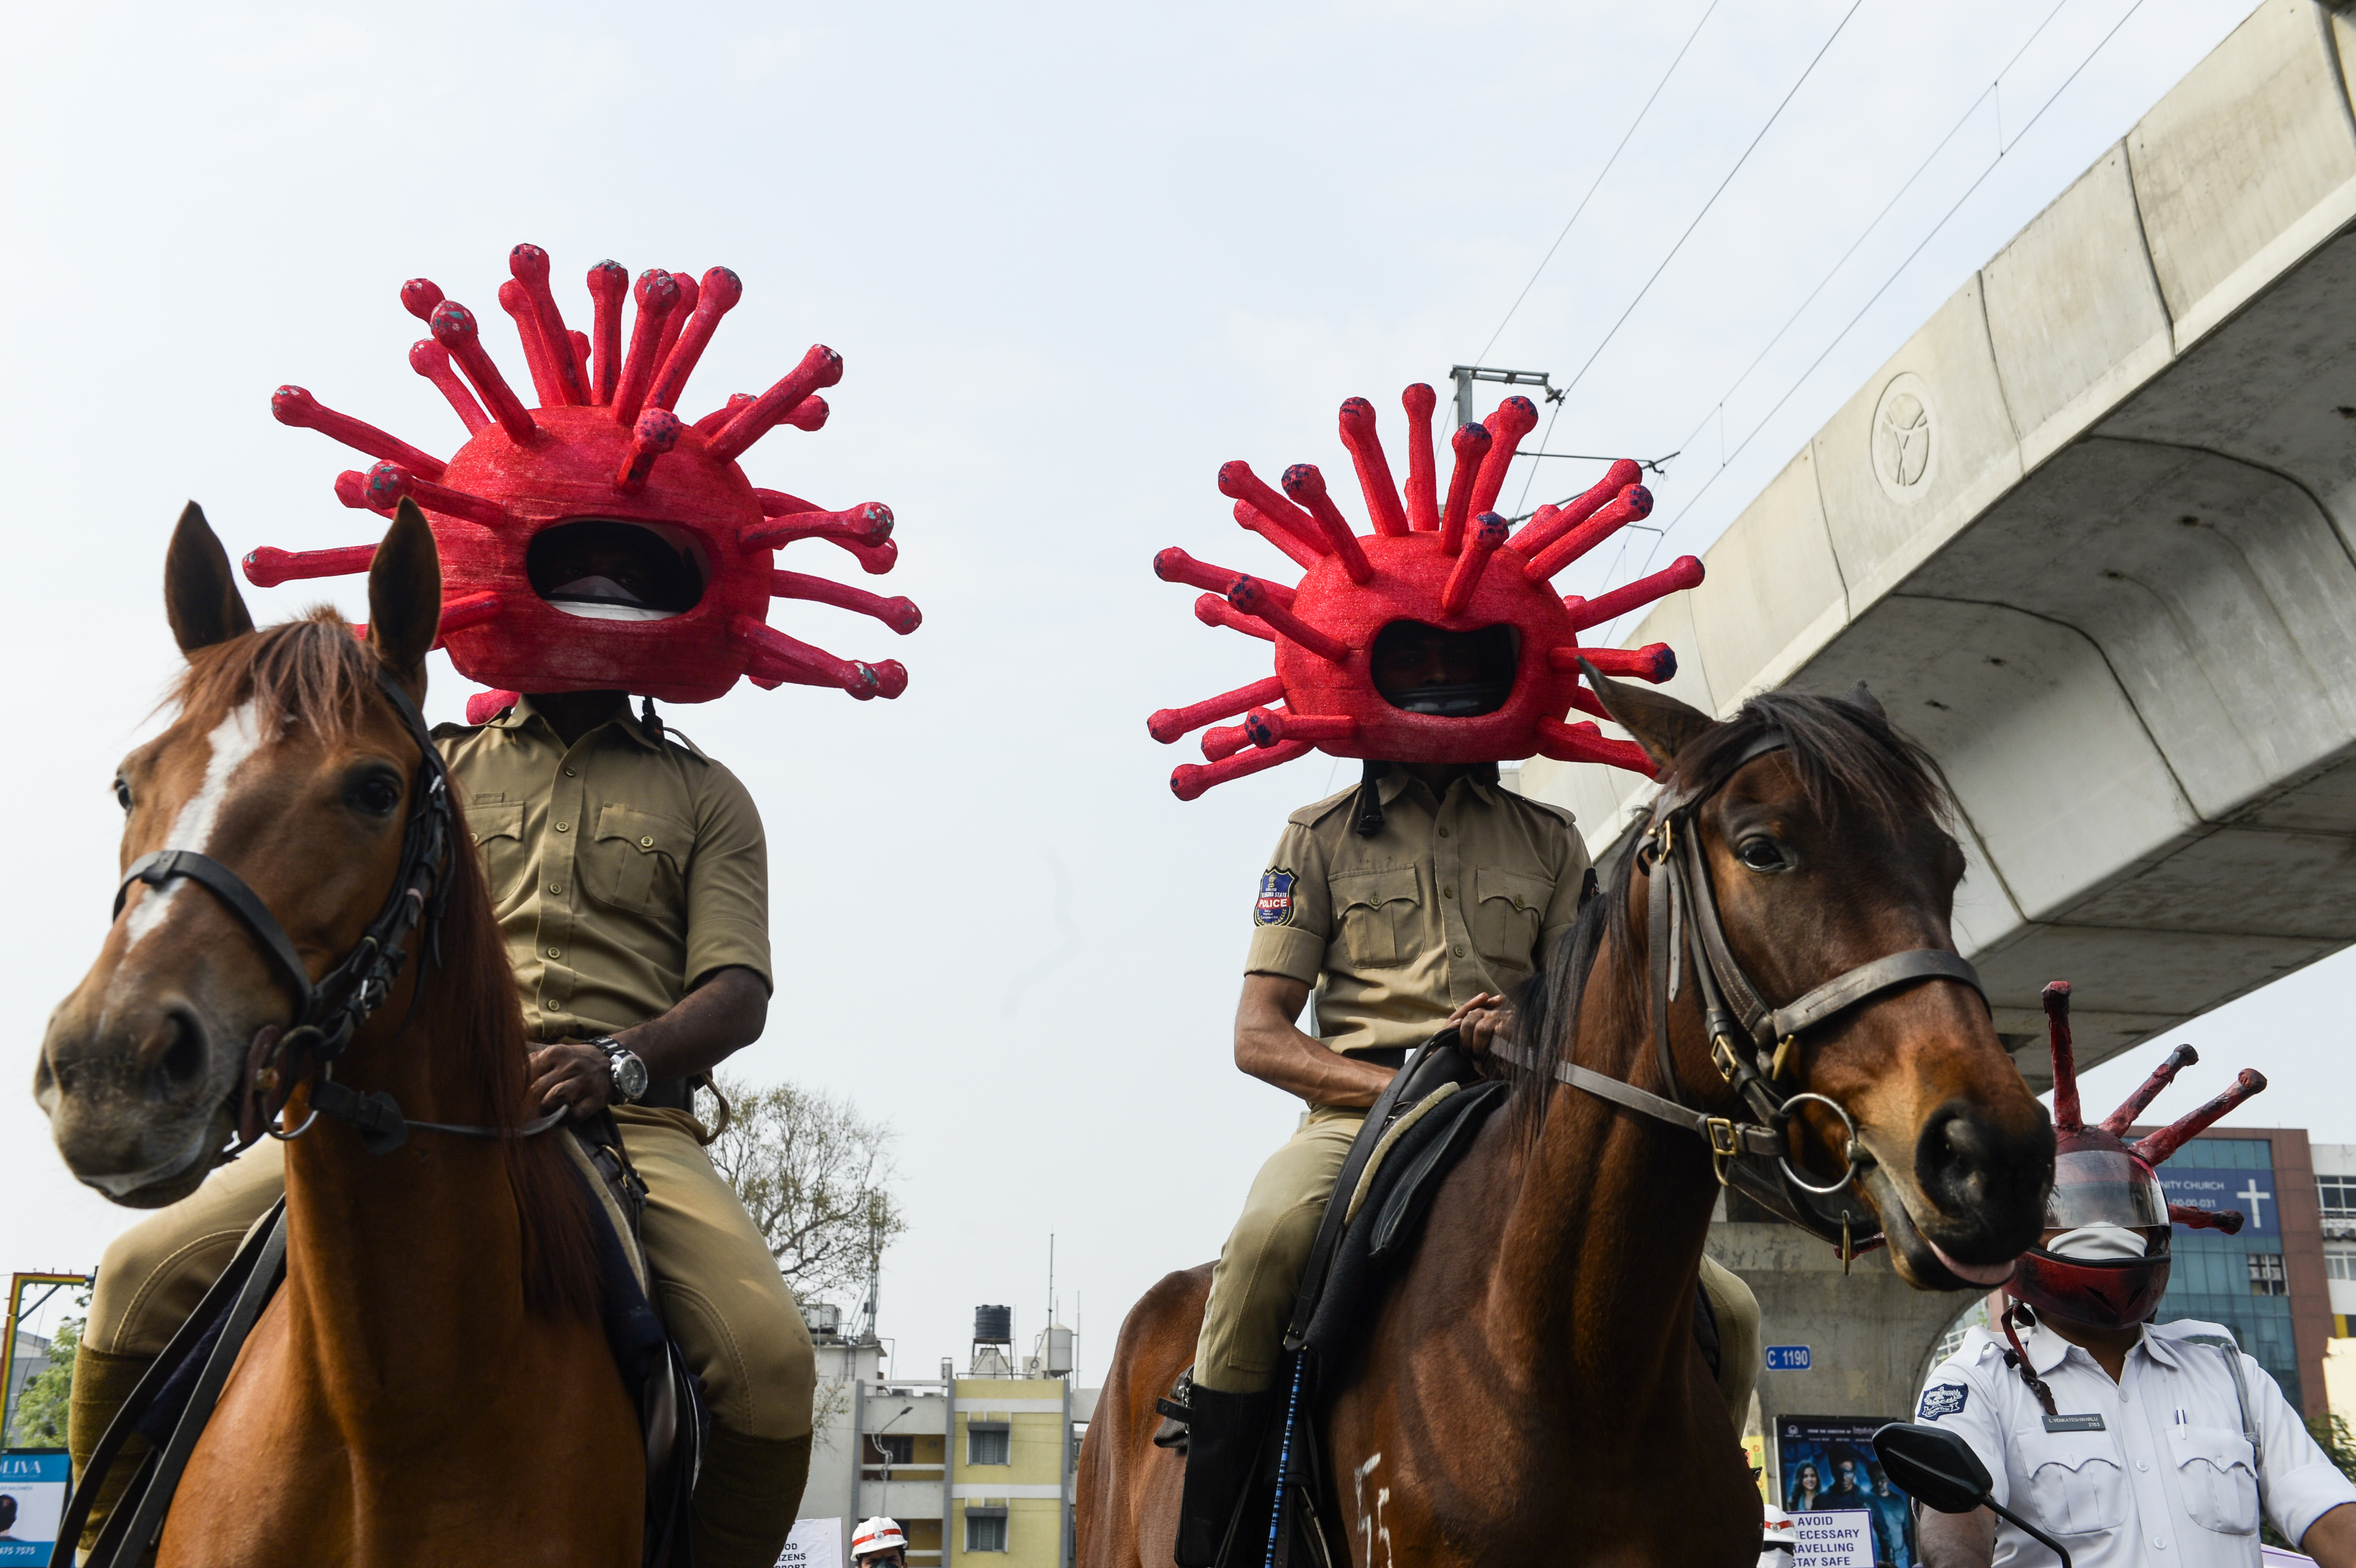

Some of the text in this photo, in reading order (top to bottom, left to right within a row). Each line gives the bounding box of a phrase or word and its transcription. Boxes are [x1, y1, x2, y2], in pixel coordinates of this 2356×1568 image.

[1259, 899, 1287, 908] POLICE
[2183, 1180, 2225, 1190] CHURCH
[1767, 1350, 1808, 1366] C 1190
[1798, 1516, 1833, 1526] AVOID
[1796, 1529, 1859, 1539] ECESSARY
[1792, 1557, 1851, 1567] STAY SAFE
